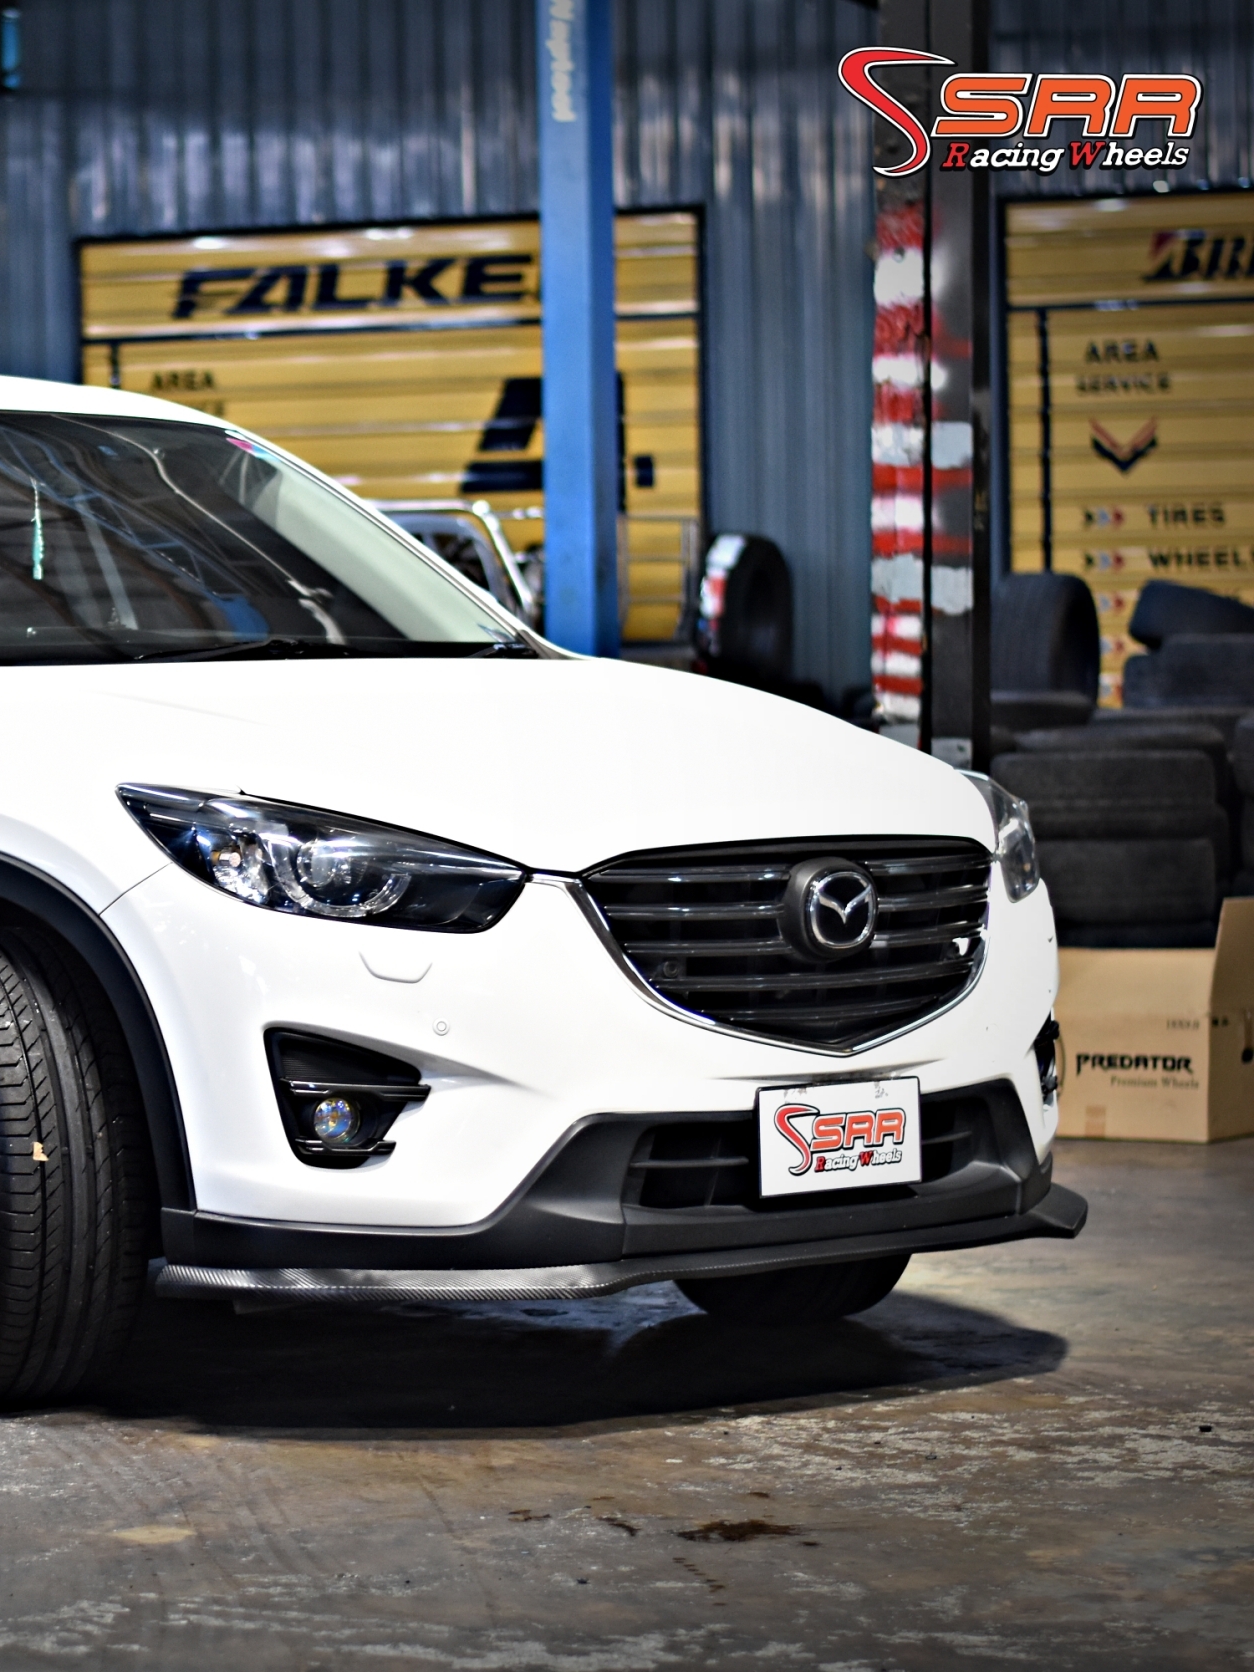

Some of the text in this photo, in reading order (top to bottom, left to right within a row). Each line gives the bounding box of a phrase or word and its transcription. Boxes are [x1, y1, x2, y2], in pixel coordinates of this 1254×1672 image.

[172, 253, 541, 320] FALKE
[1085, 340, 1160, 362] AREA
[1148, 504, 1225, 526] TIRES
[1148, 547, 1254, 569] WHEEL
[1075, 1052, 1193, 1077] PREDATOR
[814, 1148, 903, 1173] Racing Wheels
